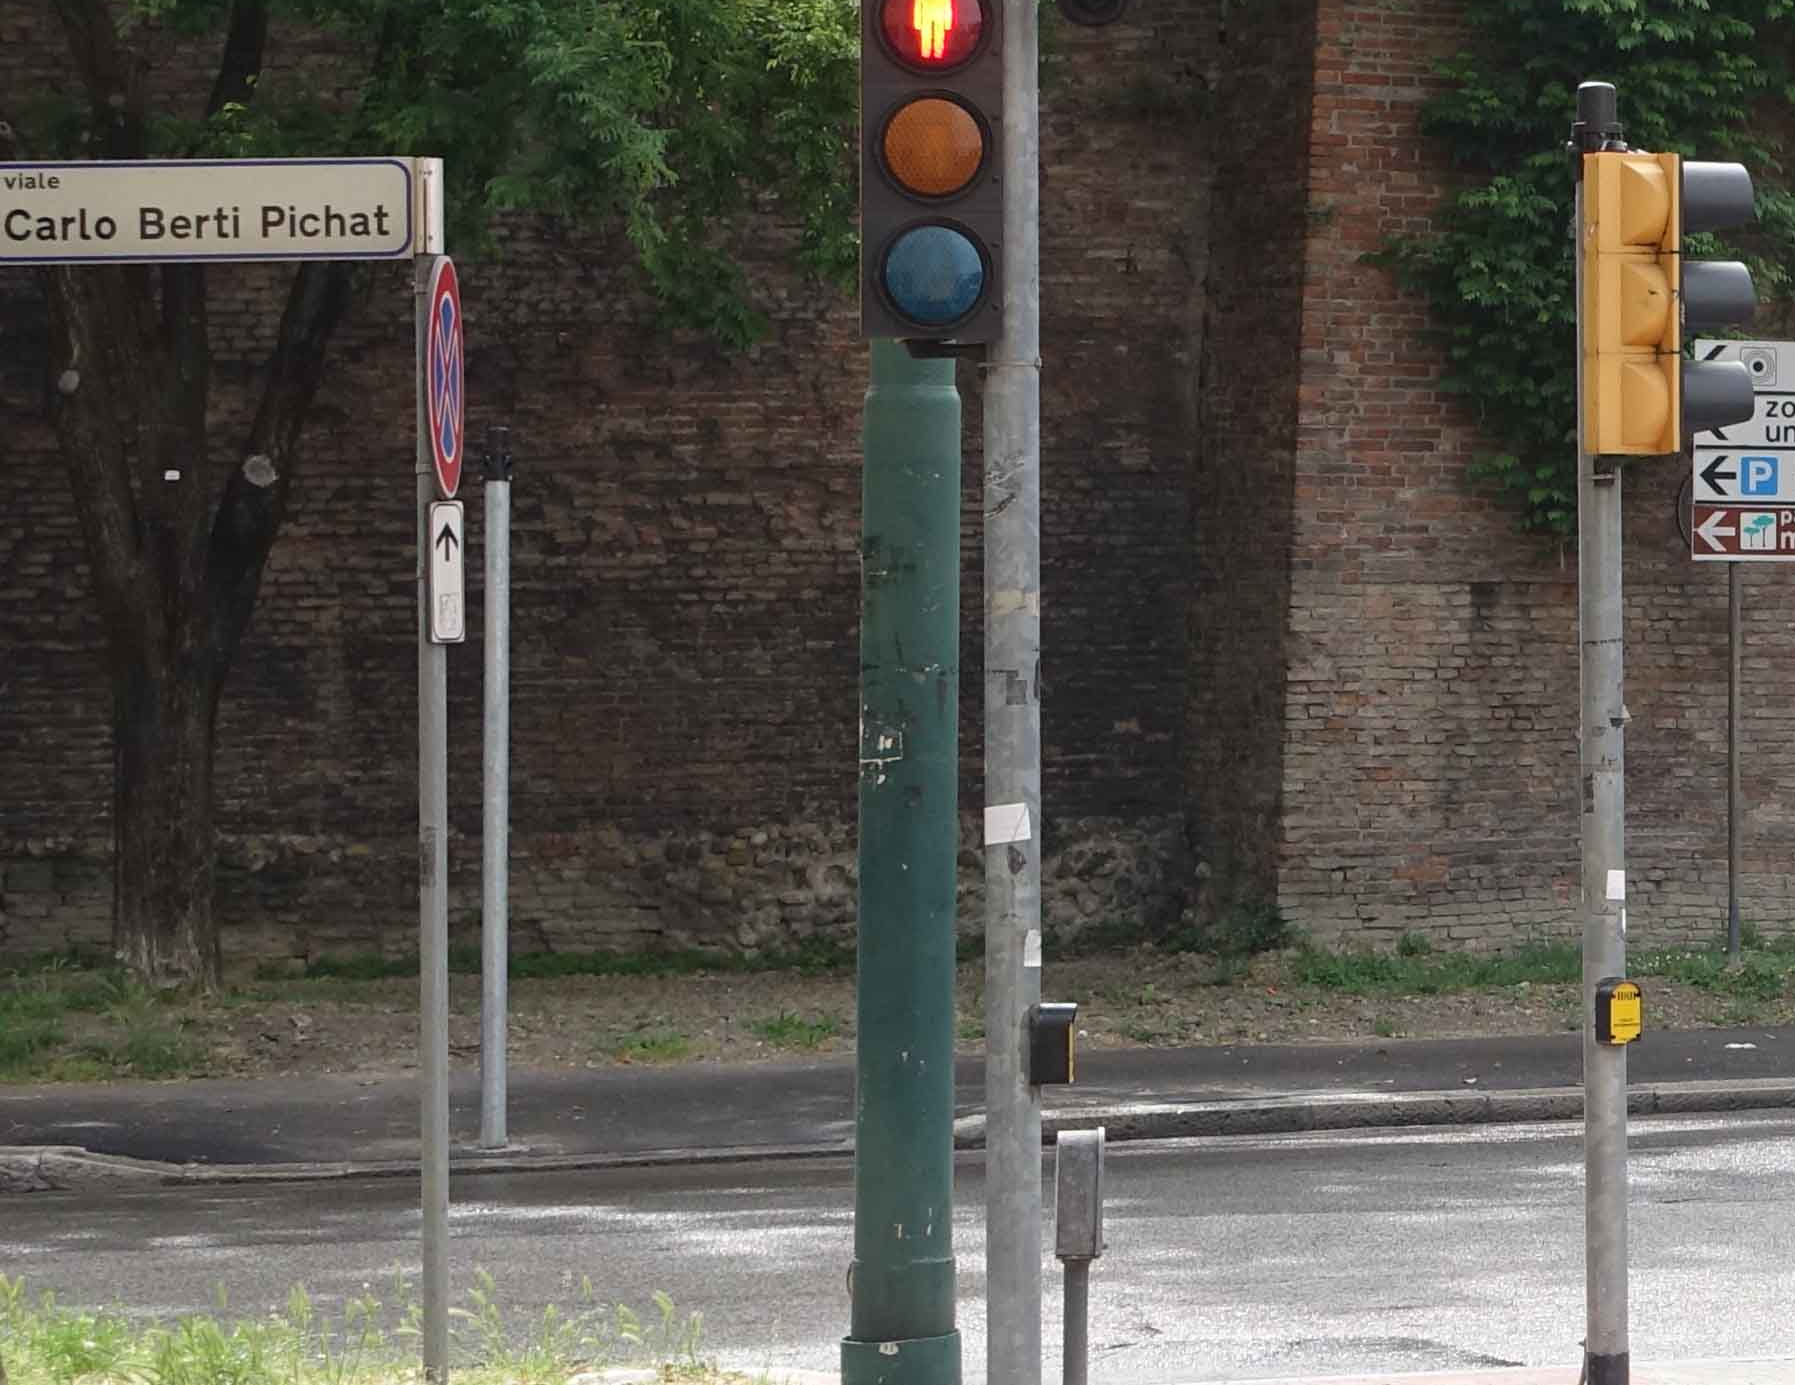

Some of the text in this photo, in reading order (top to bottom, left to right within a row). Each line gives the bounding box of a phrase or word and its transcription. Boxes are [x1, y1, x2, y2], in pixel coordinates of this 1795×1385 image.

[4, 172, 61, 191] viale
[4, 205, 390, 241] Carlo Berti Pichat
[1750, 461, 1773, 492] P
